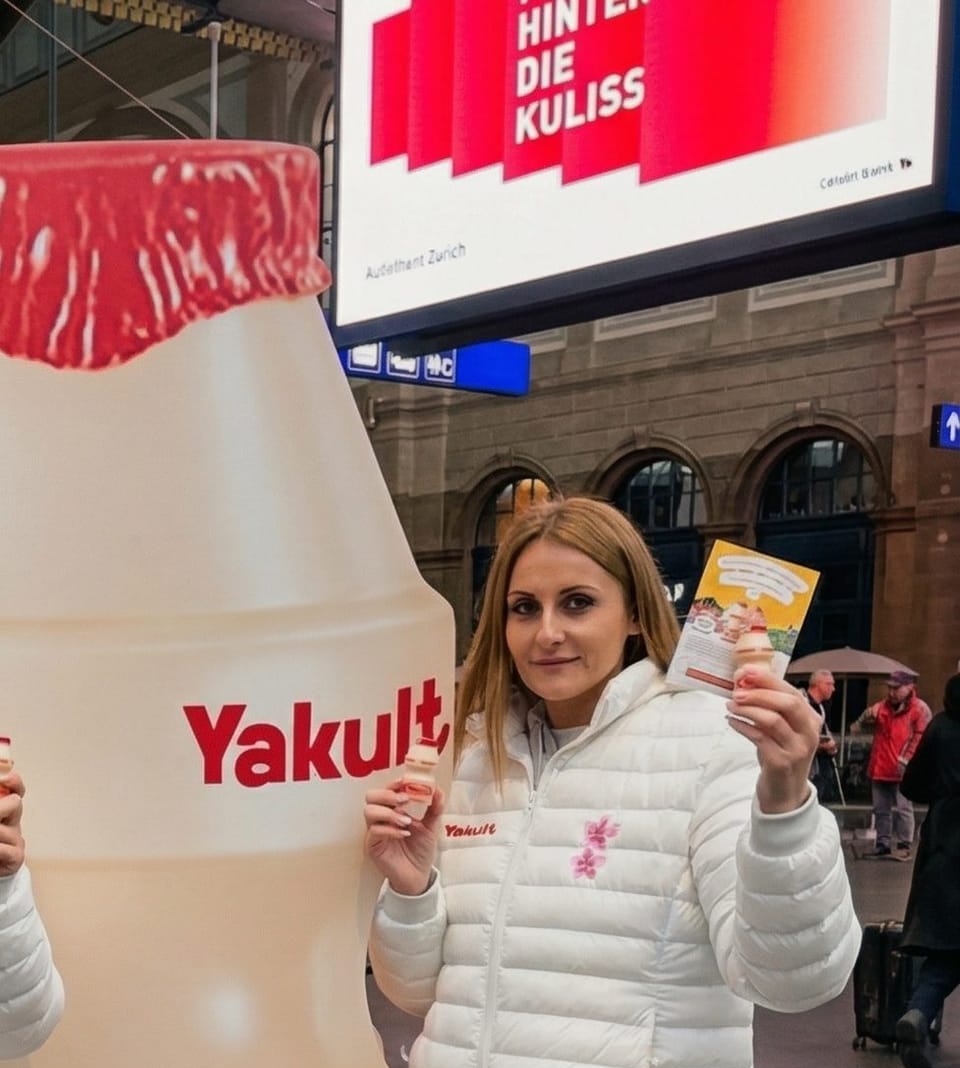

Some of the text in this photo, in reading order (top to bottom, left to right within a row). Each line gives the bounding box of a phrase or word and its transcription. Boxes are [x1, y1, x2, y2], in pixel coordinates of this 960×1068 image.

[516, 40, 576, 98] DIE
[515, 66, 646, 145] KULISS
[444, 823, 497, 838] Yakult
